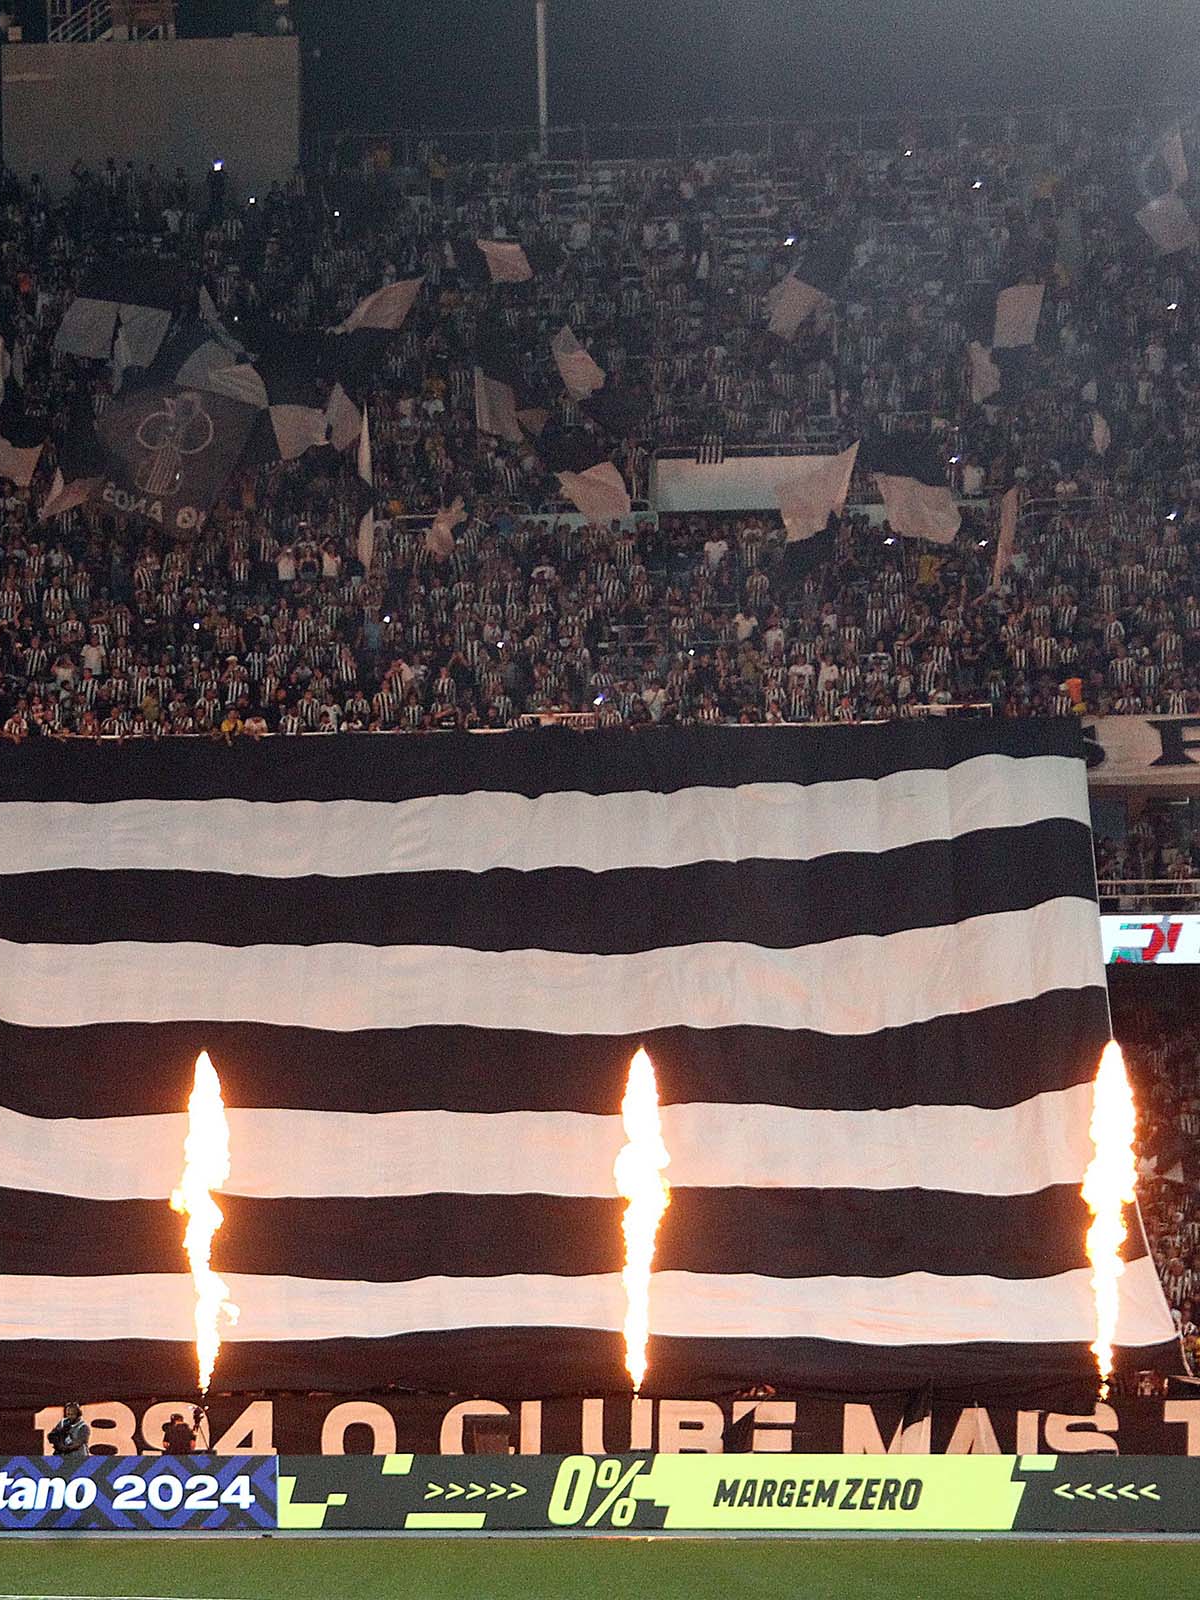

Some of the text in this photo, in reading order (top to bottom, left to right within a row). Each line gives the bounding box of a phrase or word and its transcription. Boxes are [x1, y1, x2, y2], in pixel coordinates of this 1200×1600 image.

[321, 1401, 397, 1456] O
[112, 1474, 255, 1511] 2024
[548, 1454, 647, 1527] 0%
